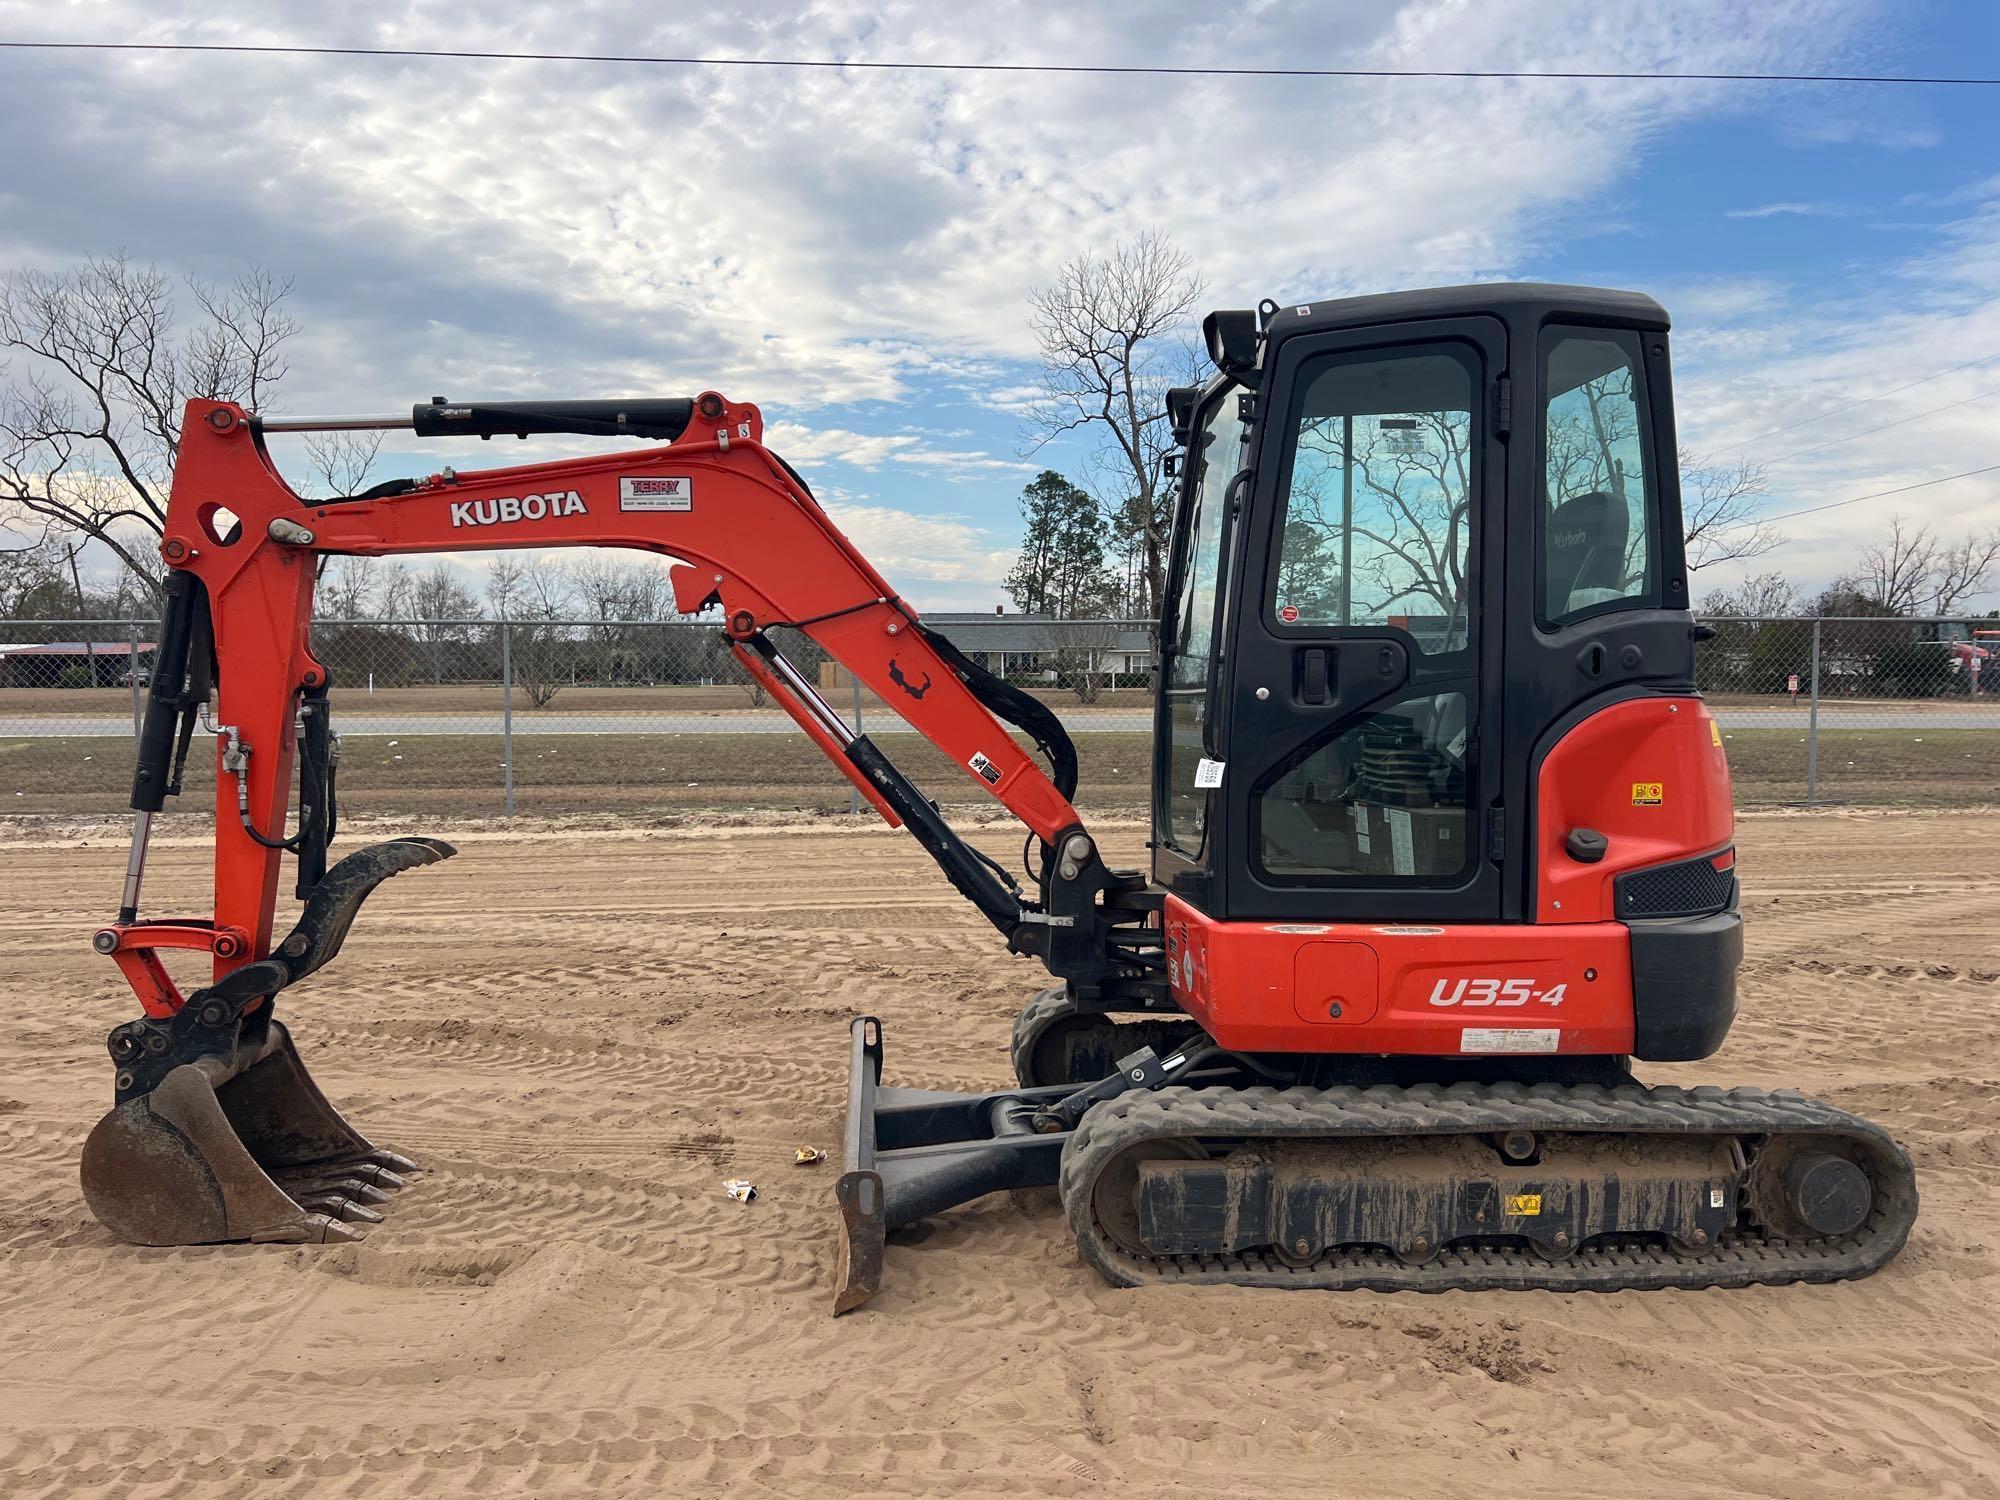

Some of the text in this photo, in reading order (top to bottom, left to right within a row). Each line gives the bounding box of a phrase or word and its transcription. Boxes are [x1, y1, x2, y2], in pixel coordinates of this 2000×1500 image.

[631, 480, 679, 493] TERRY
[450, 490, 587, 527] KUBOTA
[1429, 978, 1568, 1007] U35-4
